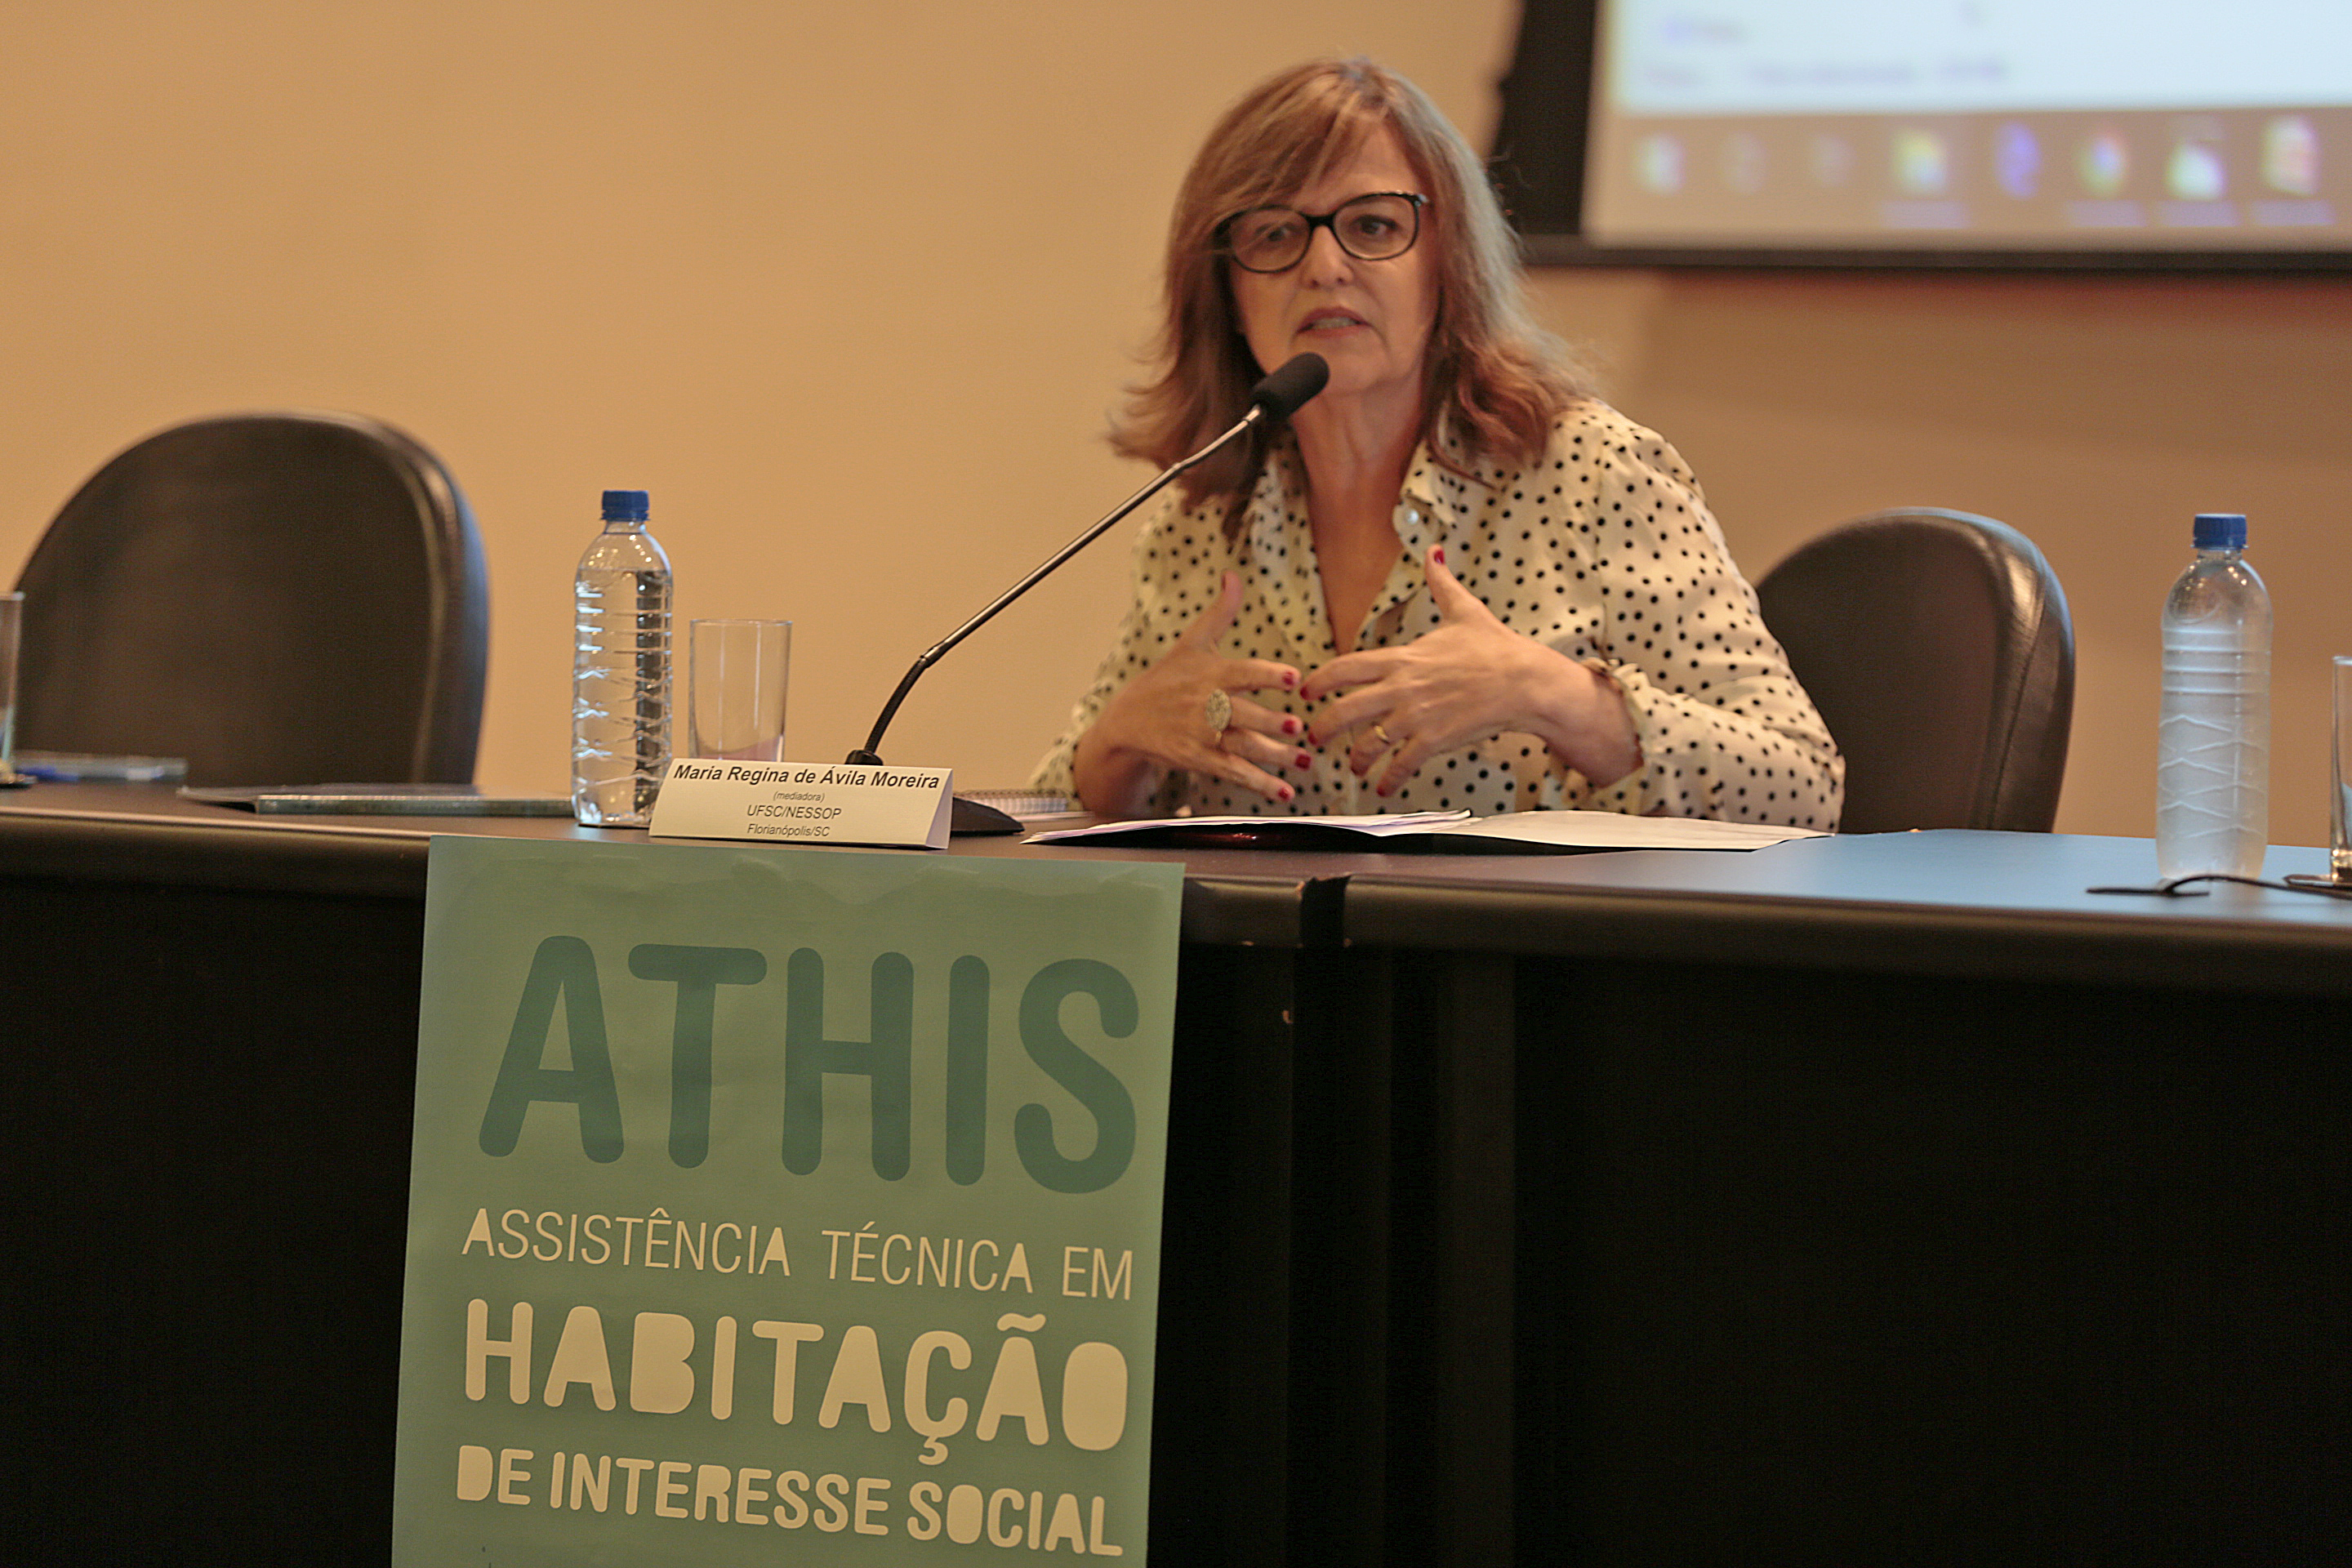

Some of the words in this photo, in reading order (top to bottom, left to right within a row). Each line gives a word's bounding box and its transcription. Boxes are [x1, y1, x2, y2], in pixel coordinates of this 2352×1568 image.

[674, 764, 722, 781] Maria
[727, 766, 790, 786] Regina
[795, 768, 816, 784] de
[819, 766, 866, 786] Ávila
[870, 772, 940, 789] Moreira
[773, 791, 825, 803] (mediadora)
[746, 804, 841, 821] UFSC/NESSOP
[746, 823, 831, 838] Florianópolis/SC
[478, 935, 1139, 1194] ATHIS
[461, 1207, 791, 1276] ASSISTÊNCIA
[822, 1221, 1033, 1294] TÉCNICA
[1061, 1245, 1133, 1300] EM
[465, 1298, 1129, 1465] HABITAÇÃO
[456, 1445, 534, 1506] DE
[550, 1450, 893, 1536] INTERESSE
[906, 1481, 1124, 1556] SOCIAL
